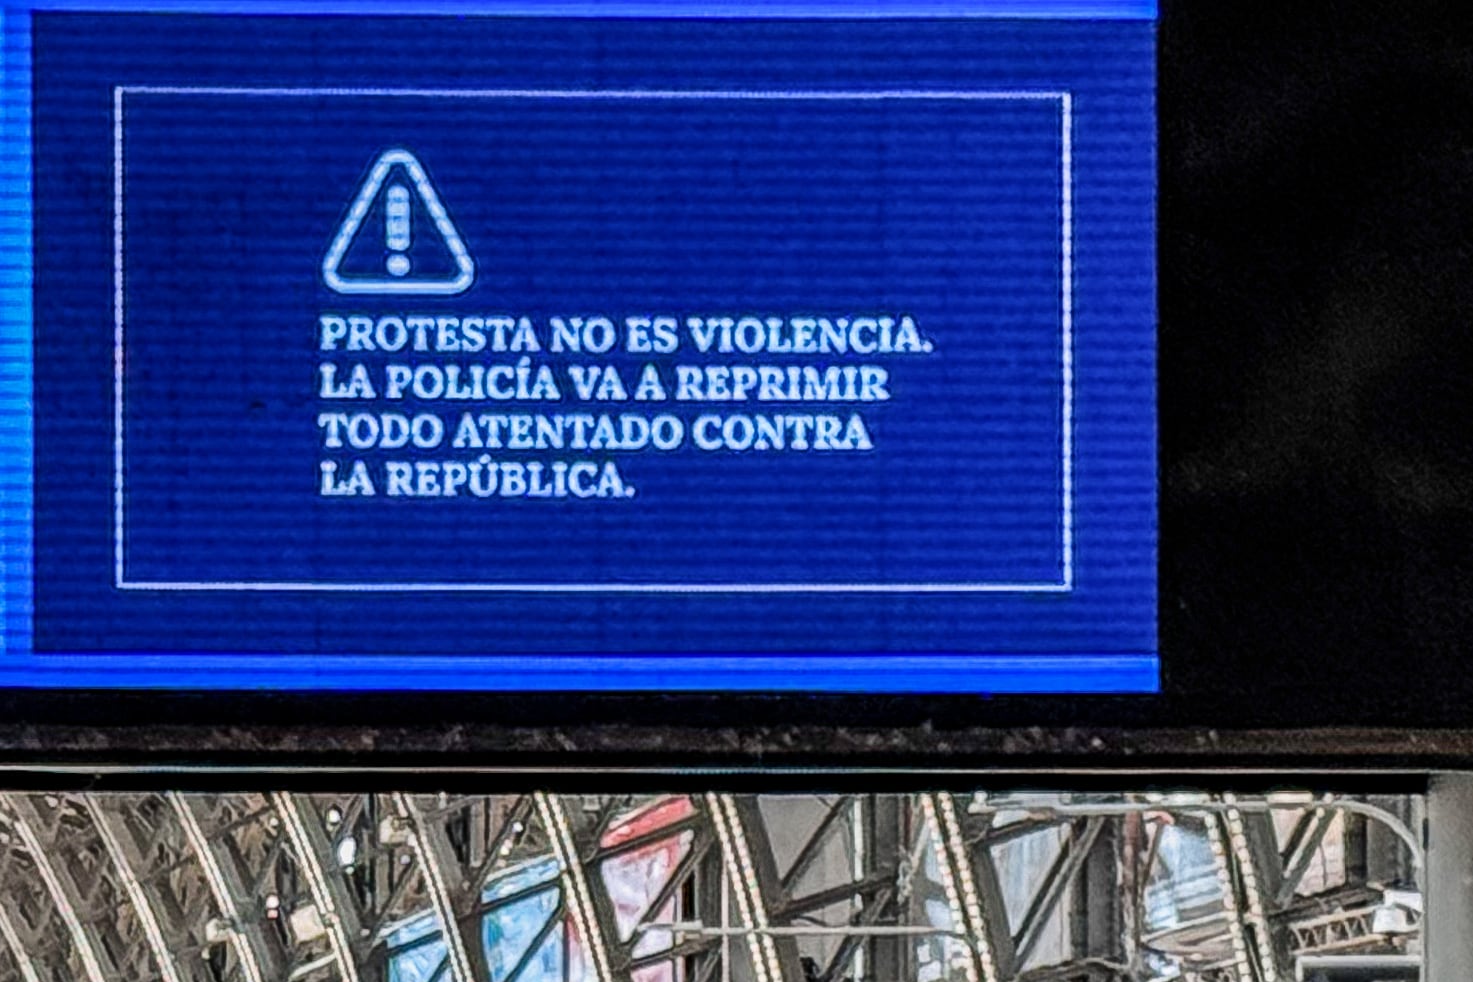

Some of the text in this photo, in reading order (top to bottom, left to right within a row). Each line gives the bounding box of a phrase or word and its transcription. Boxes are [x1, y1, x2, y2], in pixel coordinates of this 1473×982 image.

[320, 316, 932, 353] PROTESTA NO ES VIOLENCIA.
[320, 358, 889, 400] LA POLICÍA VA A REPRIMIR
[320, 413, 872, 449] TODO ATENTADO CONTRA
[320, 455, 634, 497] LA REPÚBLICA.
